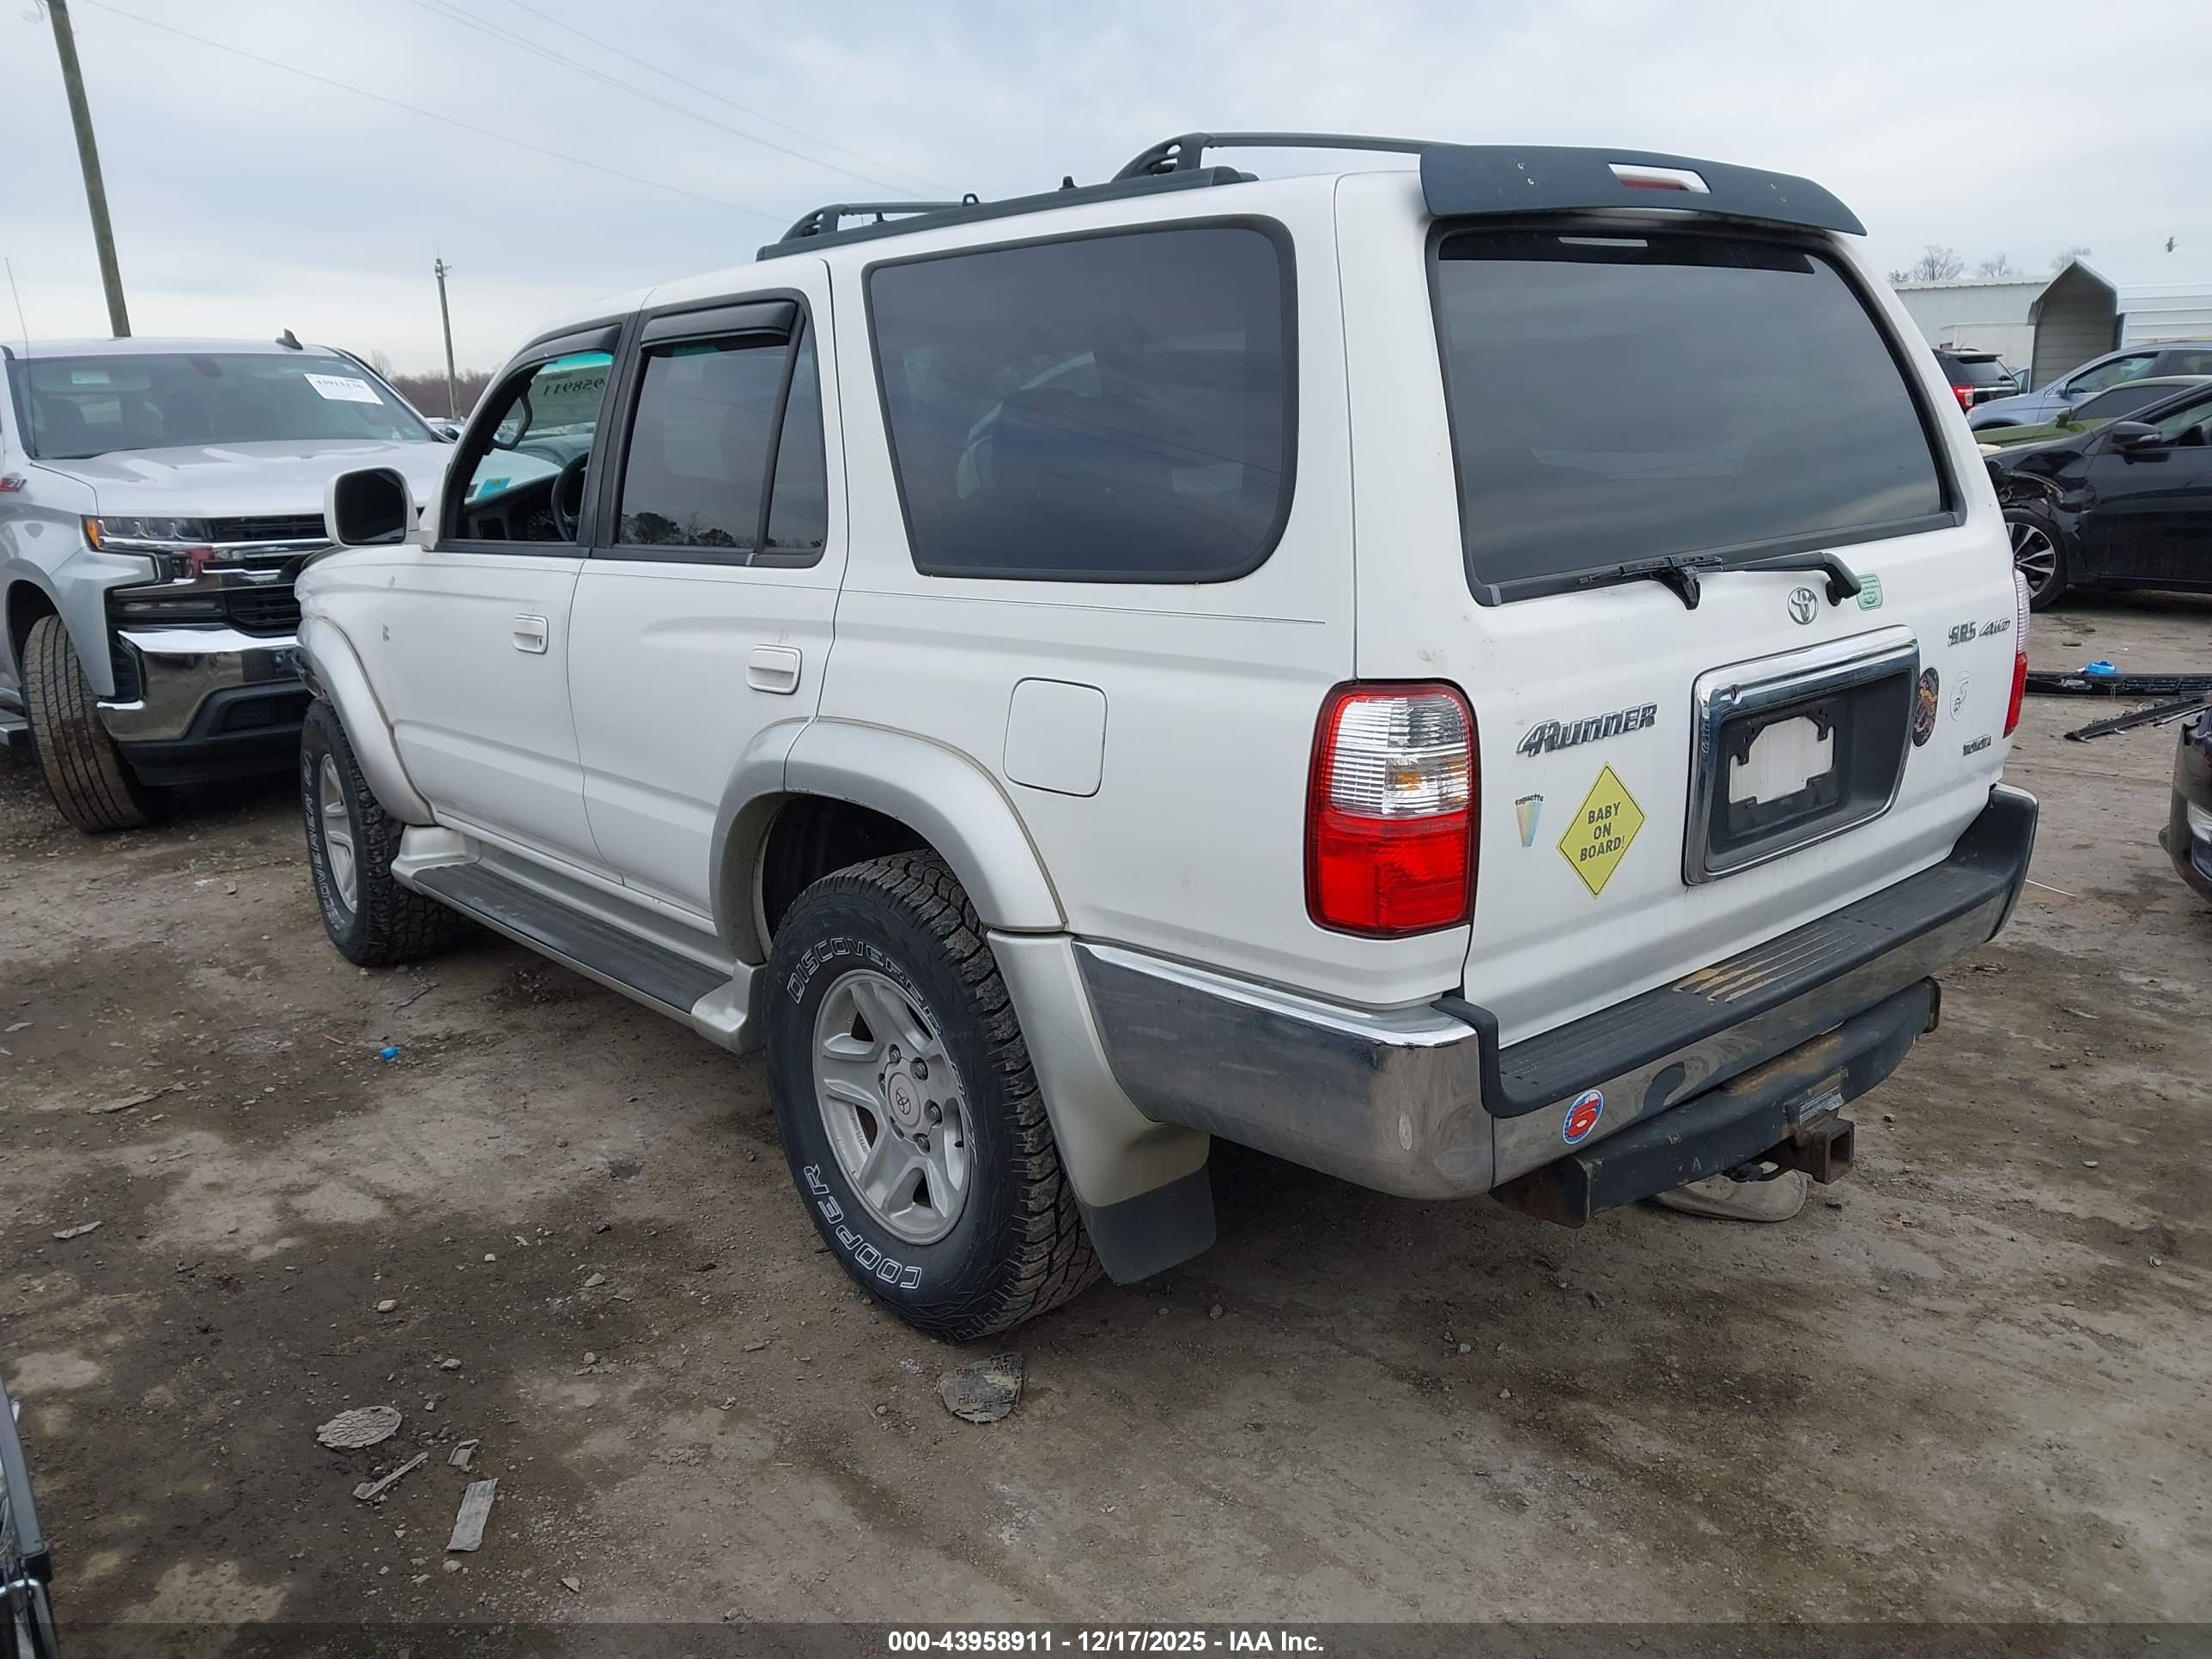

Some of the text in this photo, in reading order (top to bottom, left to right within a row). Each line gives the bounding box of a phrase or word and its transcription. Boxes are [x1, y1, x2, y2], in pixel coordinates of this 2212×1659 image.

[1587, 801, 1621, 825] BABY
[1593, 822, 1613, 841] ON
[1579, 835, 1626, 863] BOARD!
[787, 937, 942, 1036] DISCOVERER
[804, 1164, 922, 1290] COOPER
